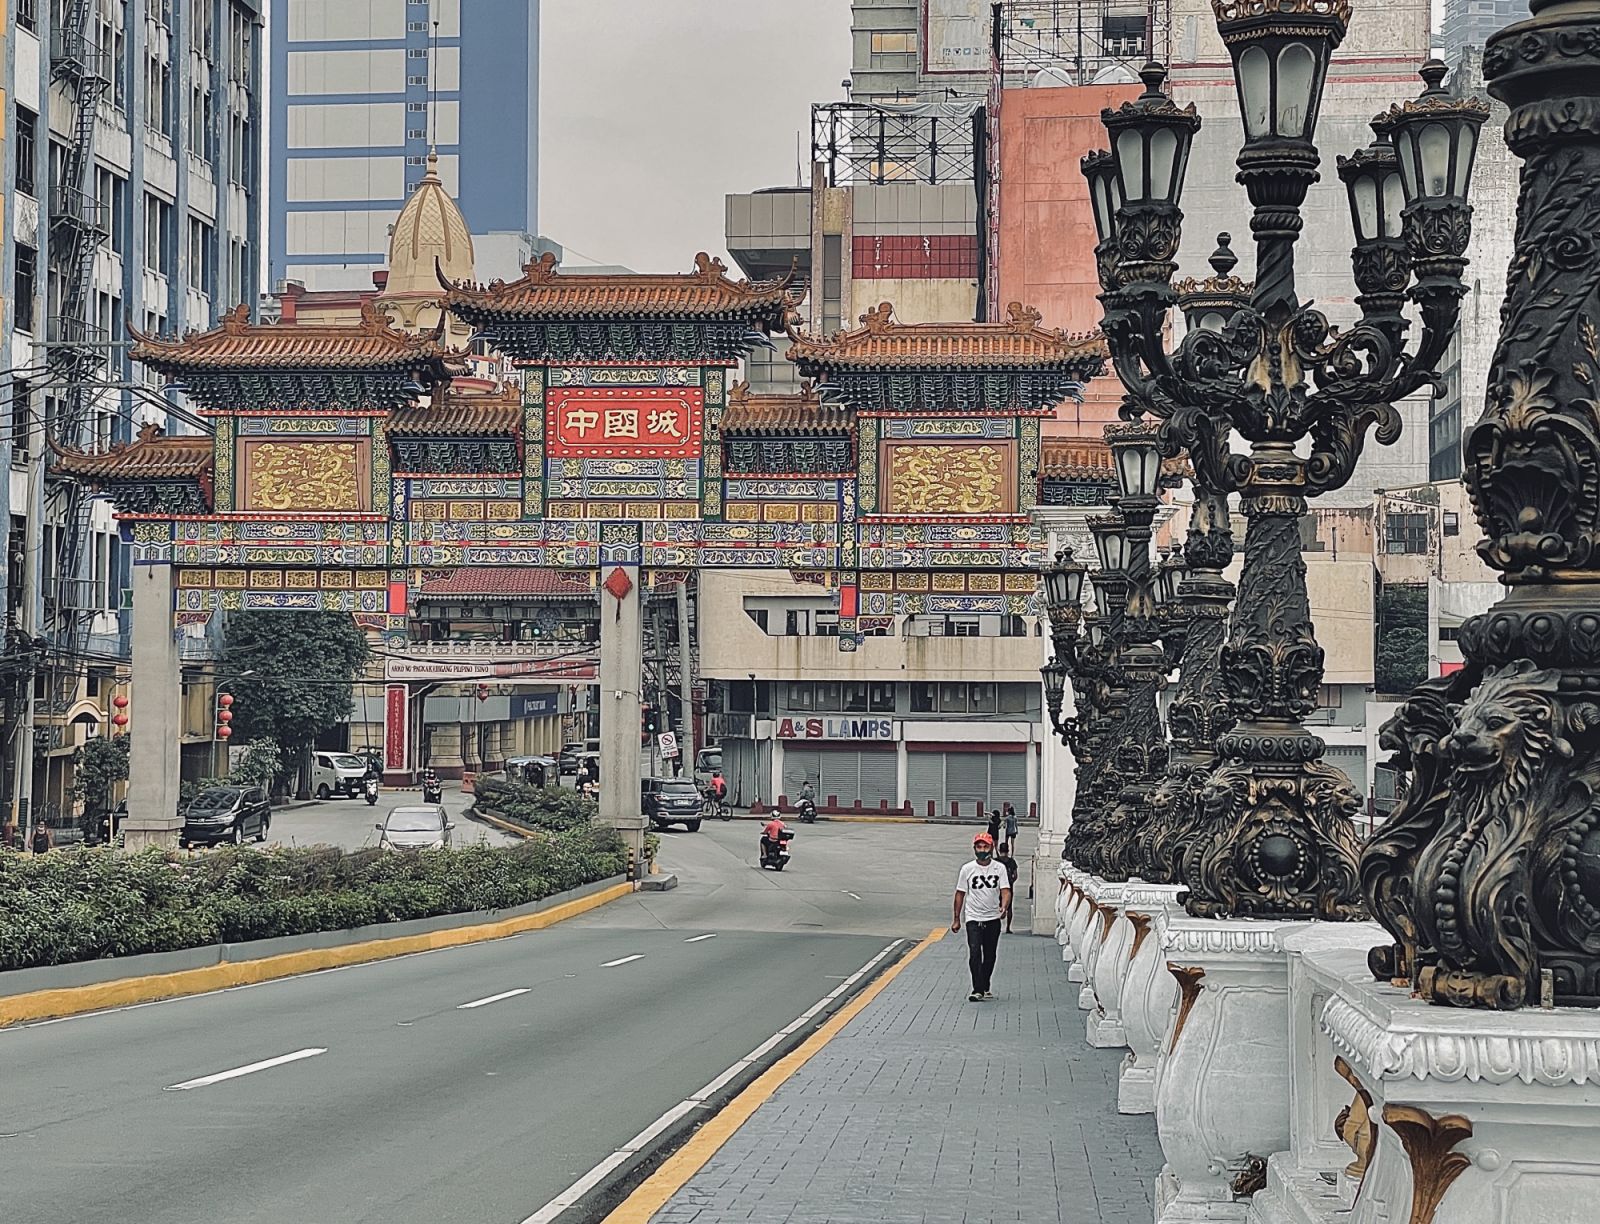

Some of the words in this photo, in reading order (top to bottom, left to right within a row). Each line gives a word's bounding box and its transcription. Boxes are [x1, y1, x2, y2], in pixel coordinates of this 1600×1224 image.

[565, 408, 682, 439] 中國城
[827, 719, 891, 738] LAMPS
